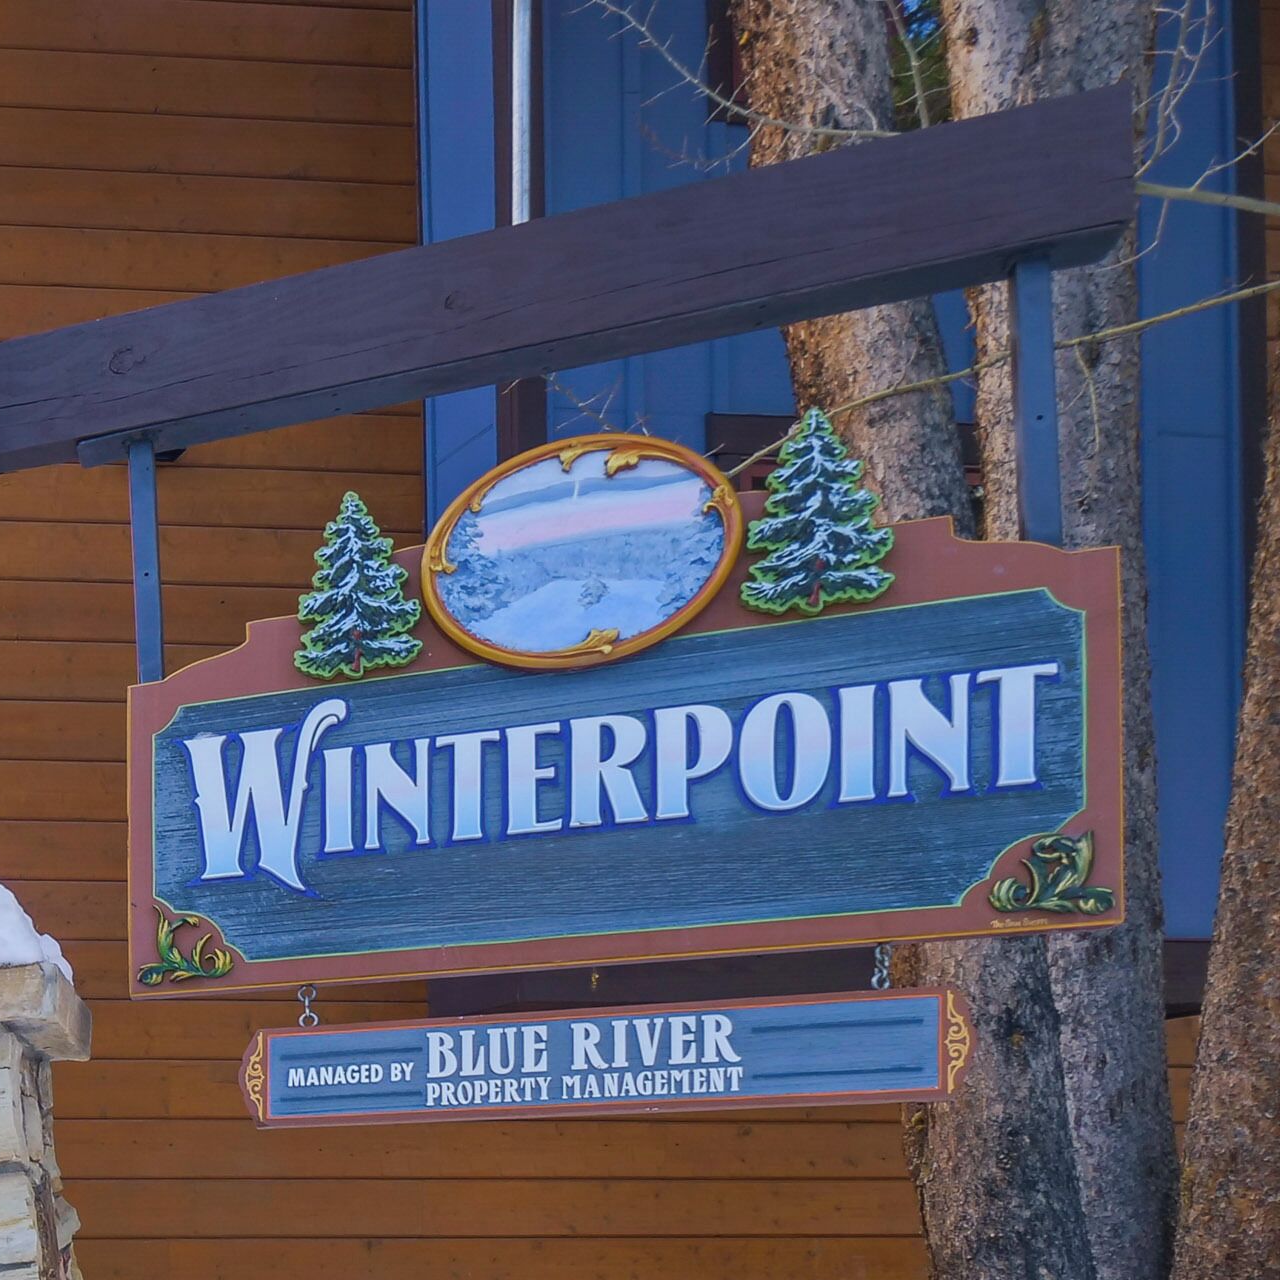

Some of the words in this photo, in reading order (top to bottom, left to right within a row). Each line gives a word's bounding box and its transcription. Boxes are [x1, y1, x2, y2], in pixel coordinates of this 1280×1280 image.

[183, 662, 1060, 890] WINTERPOINT
[425, 1024, 549, 1078] BLUE
[570, 1013, 742, 1071] RIVER
[287, 1064, 384, 1087] MANAGED
[389, 1061, 415, 1082] BY
[425, 1076, 552, 1107] PROPERTY
[561, 1066, 744, 1100] MANAGEMENT
